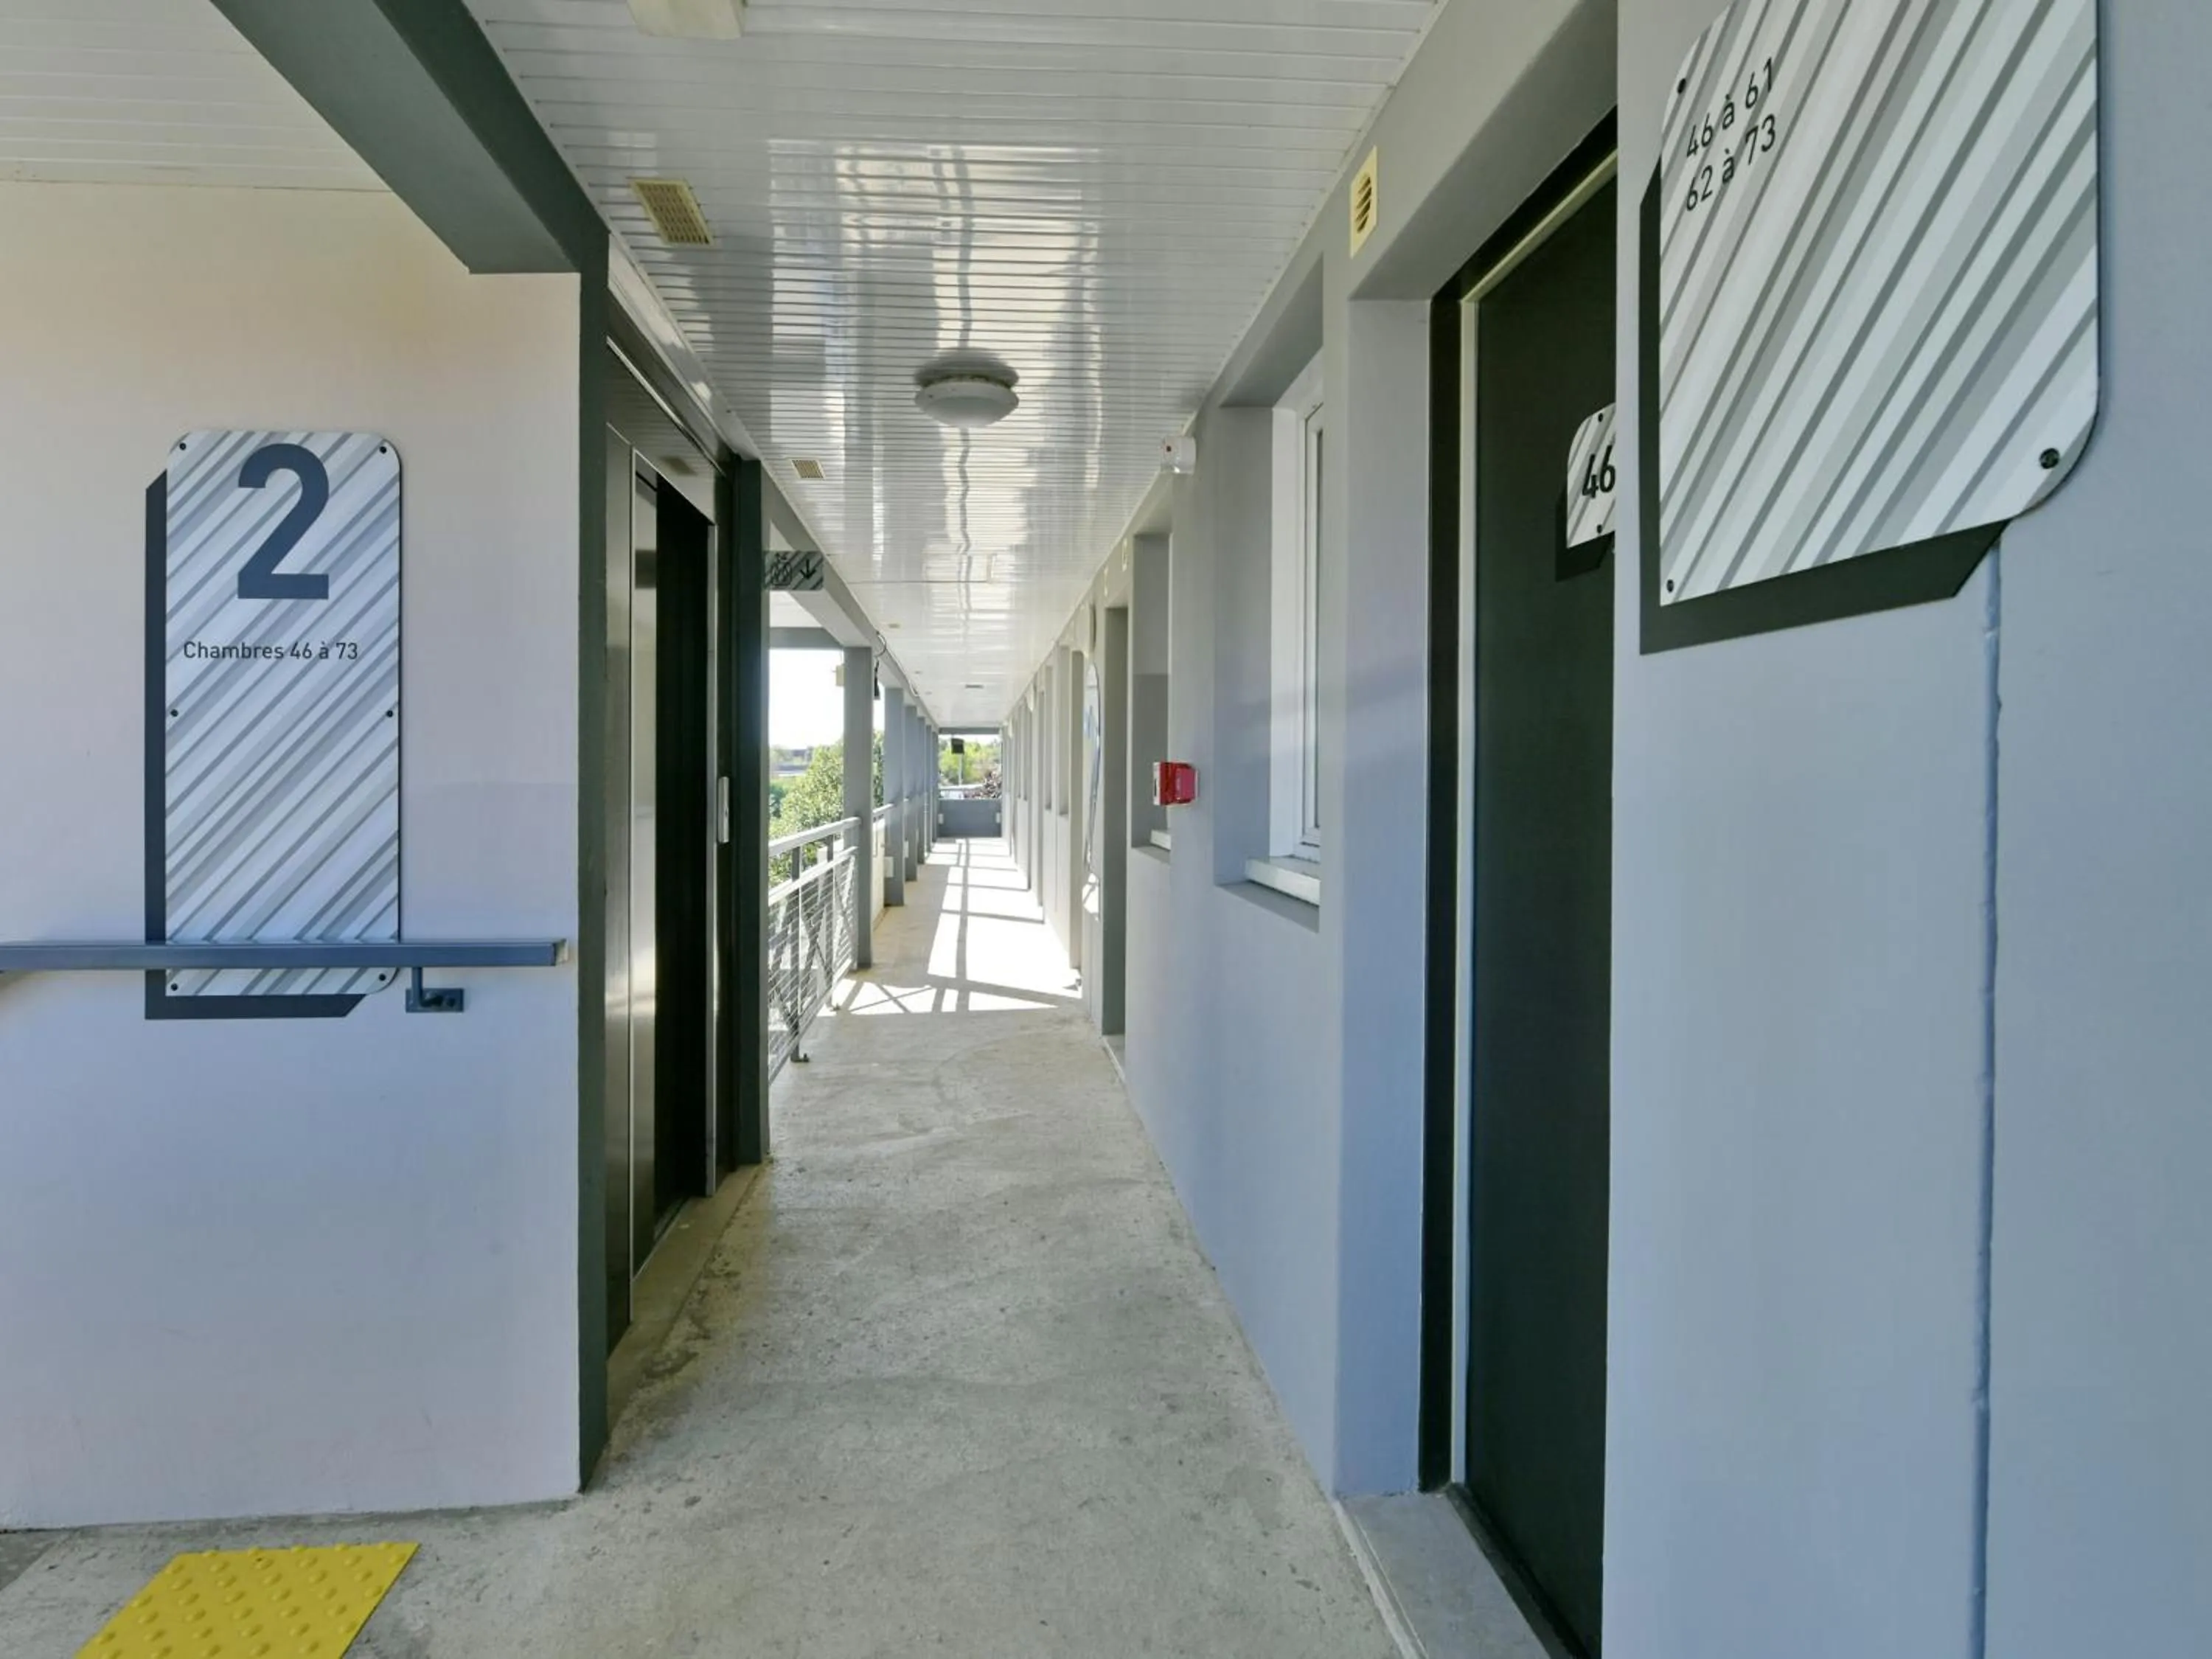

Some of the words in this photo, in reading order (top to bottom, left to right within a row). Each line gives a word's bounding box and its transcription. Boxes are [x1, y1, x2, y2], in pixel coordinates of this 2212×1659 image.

[1686, 113, 1713, 159] 46
[1722, 94, 1735, 130] à
[1745, 57, 1773, 110] 61
[1686, 164, 1713, 212] 62
[1722, 149, 1735, 184] à
[1745, 114, 1776, 165] 73
[237, 442, 329, 599] 2
[1582, 445, 1615, 498] 46
[183, 641, 284, 660] Chambres
[290, 642, 312, 660] 46
[319, 641, 329, 660] à
[335, 642, 358, 660] 73
